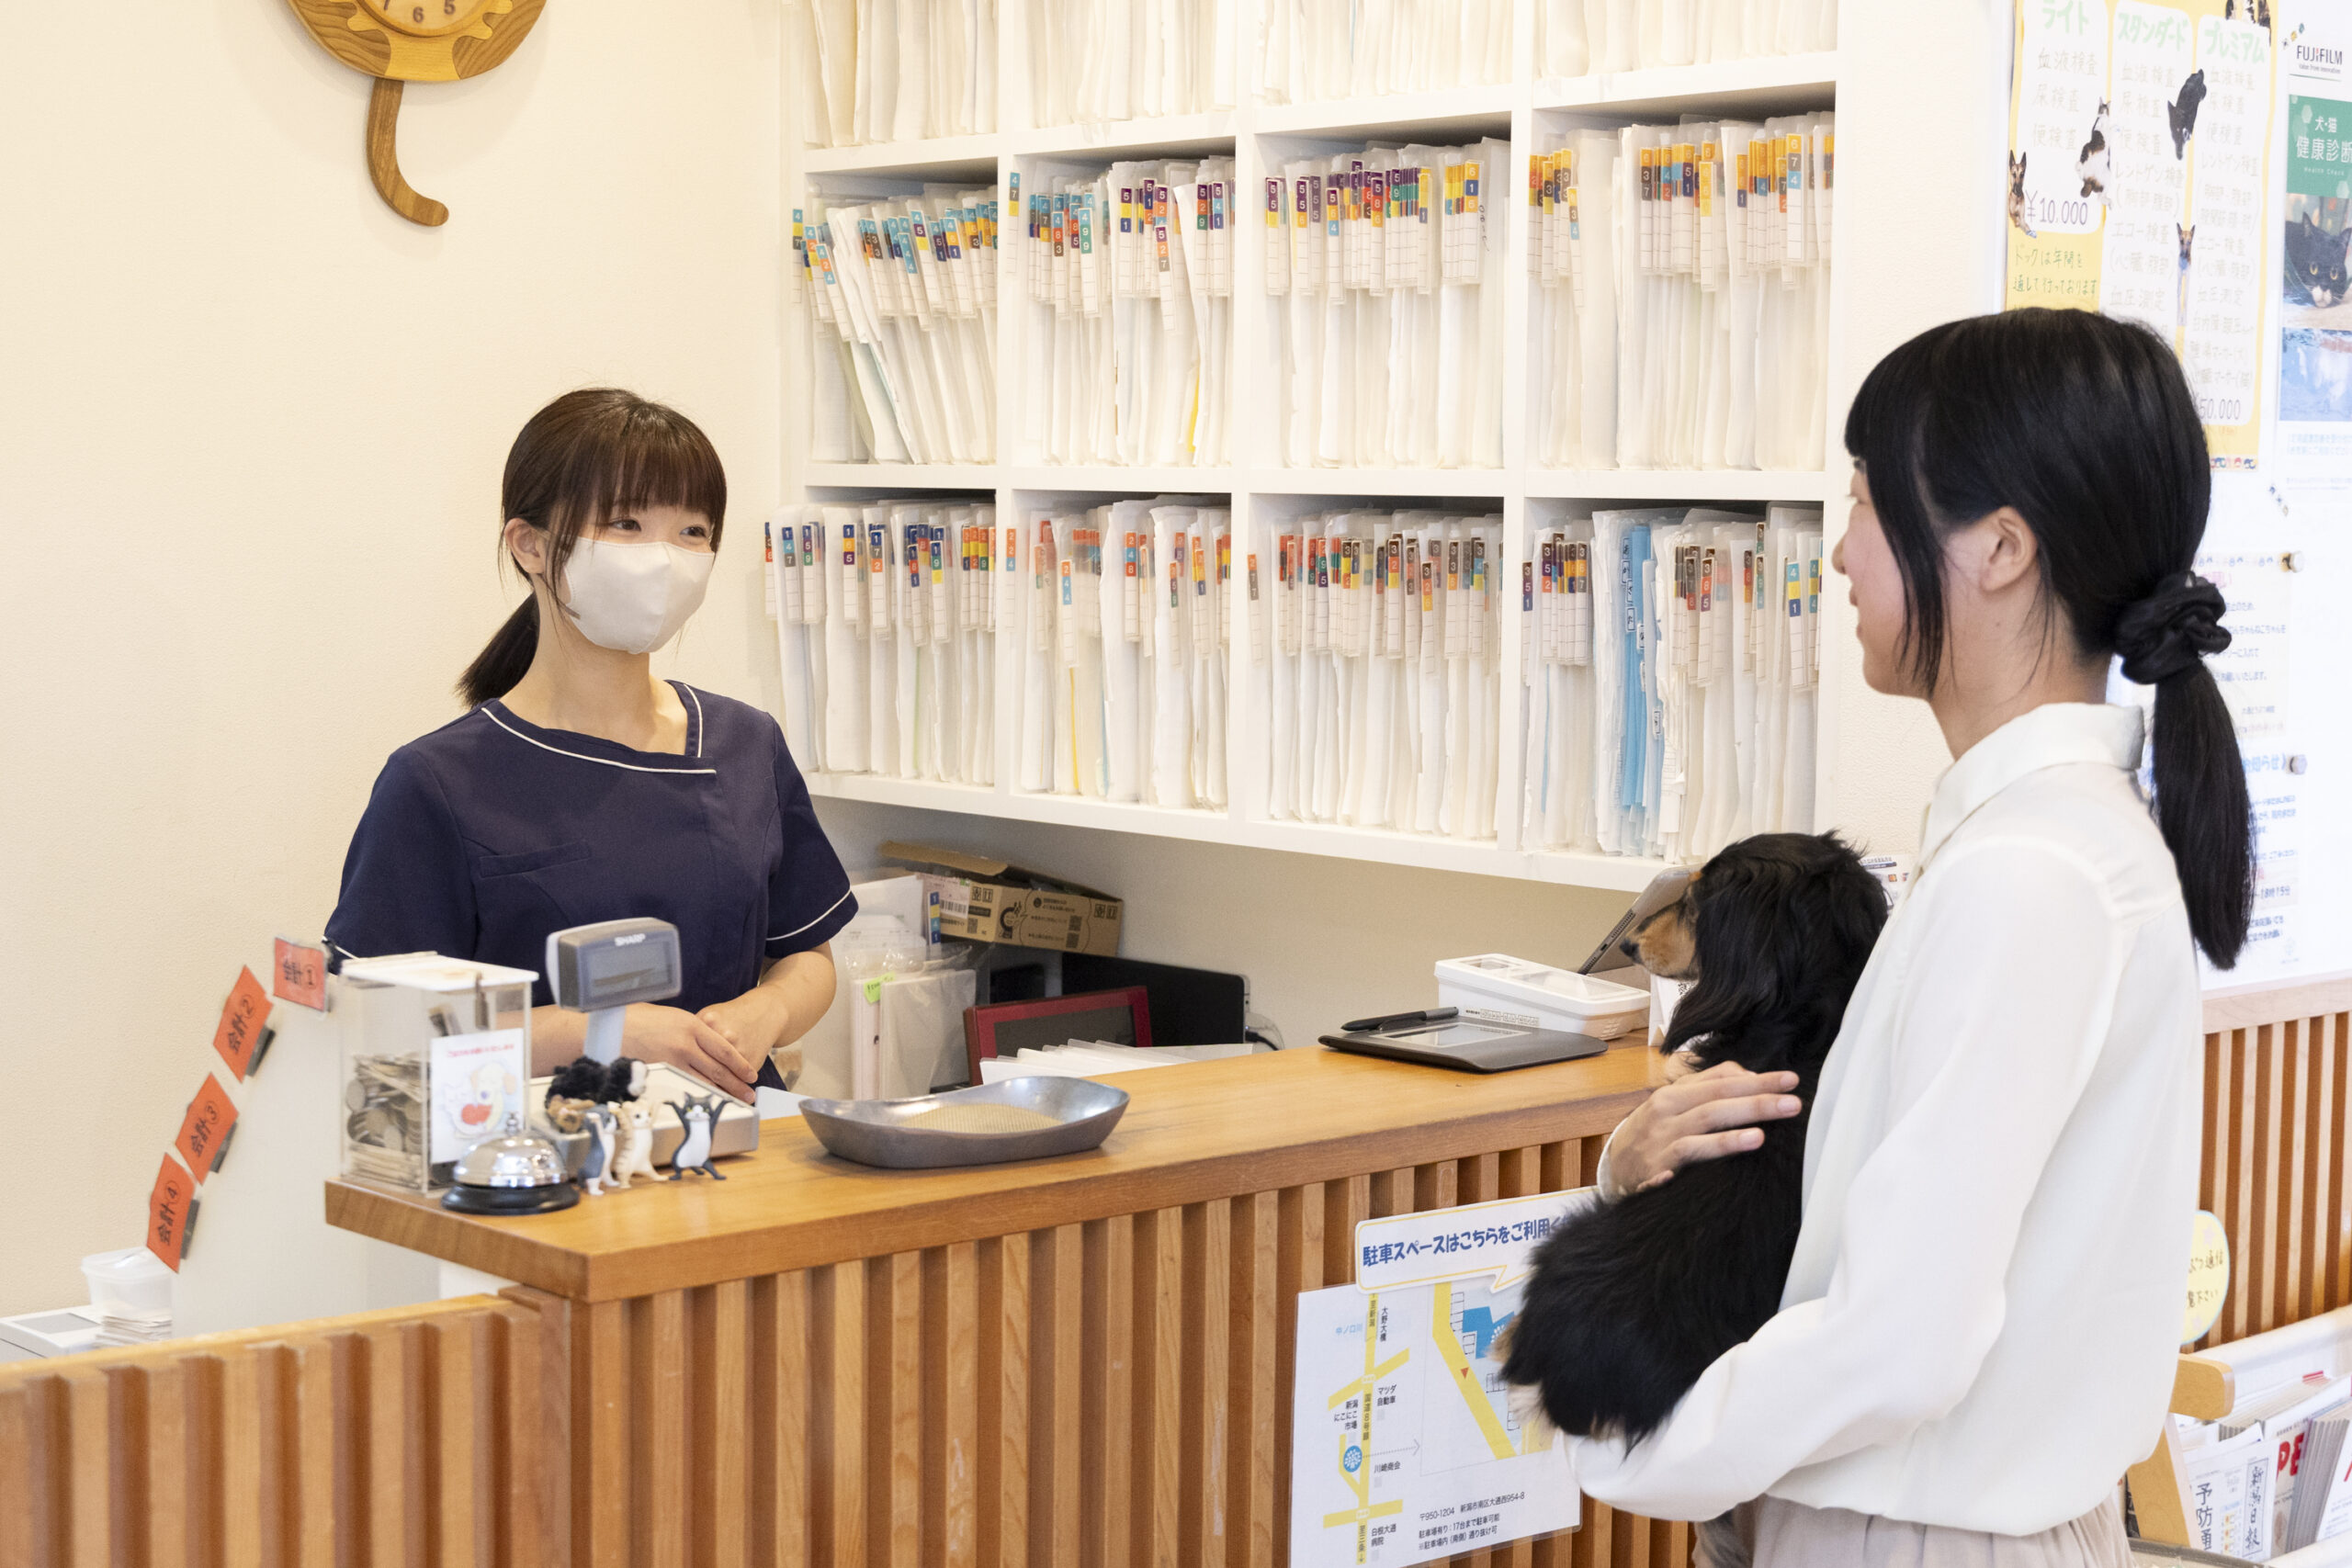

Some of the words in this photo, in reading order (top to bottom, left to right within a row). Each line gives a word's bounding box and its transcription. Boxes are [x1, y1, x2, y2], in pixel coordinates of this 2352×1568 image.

[413, 7, 424, 23] 6
[444, 0, 457, 15] 5
[2041, 0, 2089, 35] ライト
[2118, 13, 2188, 51] スタンダード
[2205, 20, 2266, 63] プレミアム
[2037, 48, 2098, 76] 血液検査
[2297, 45, 2343, 65] FUJIFILM
[2297, 136, 2352, 164] 健康診断
[615, 933, 646, 946] SHARP
[1377, 1395, 1396, 1406] 自動車
[1334, 1410, 1358, 1423] にこにこ
